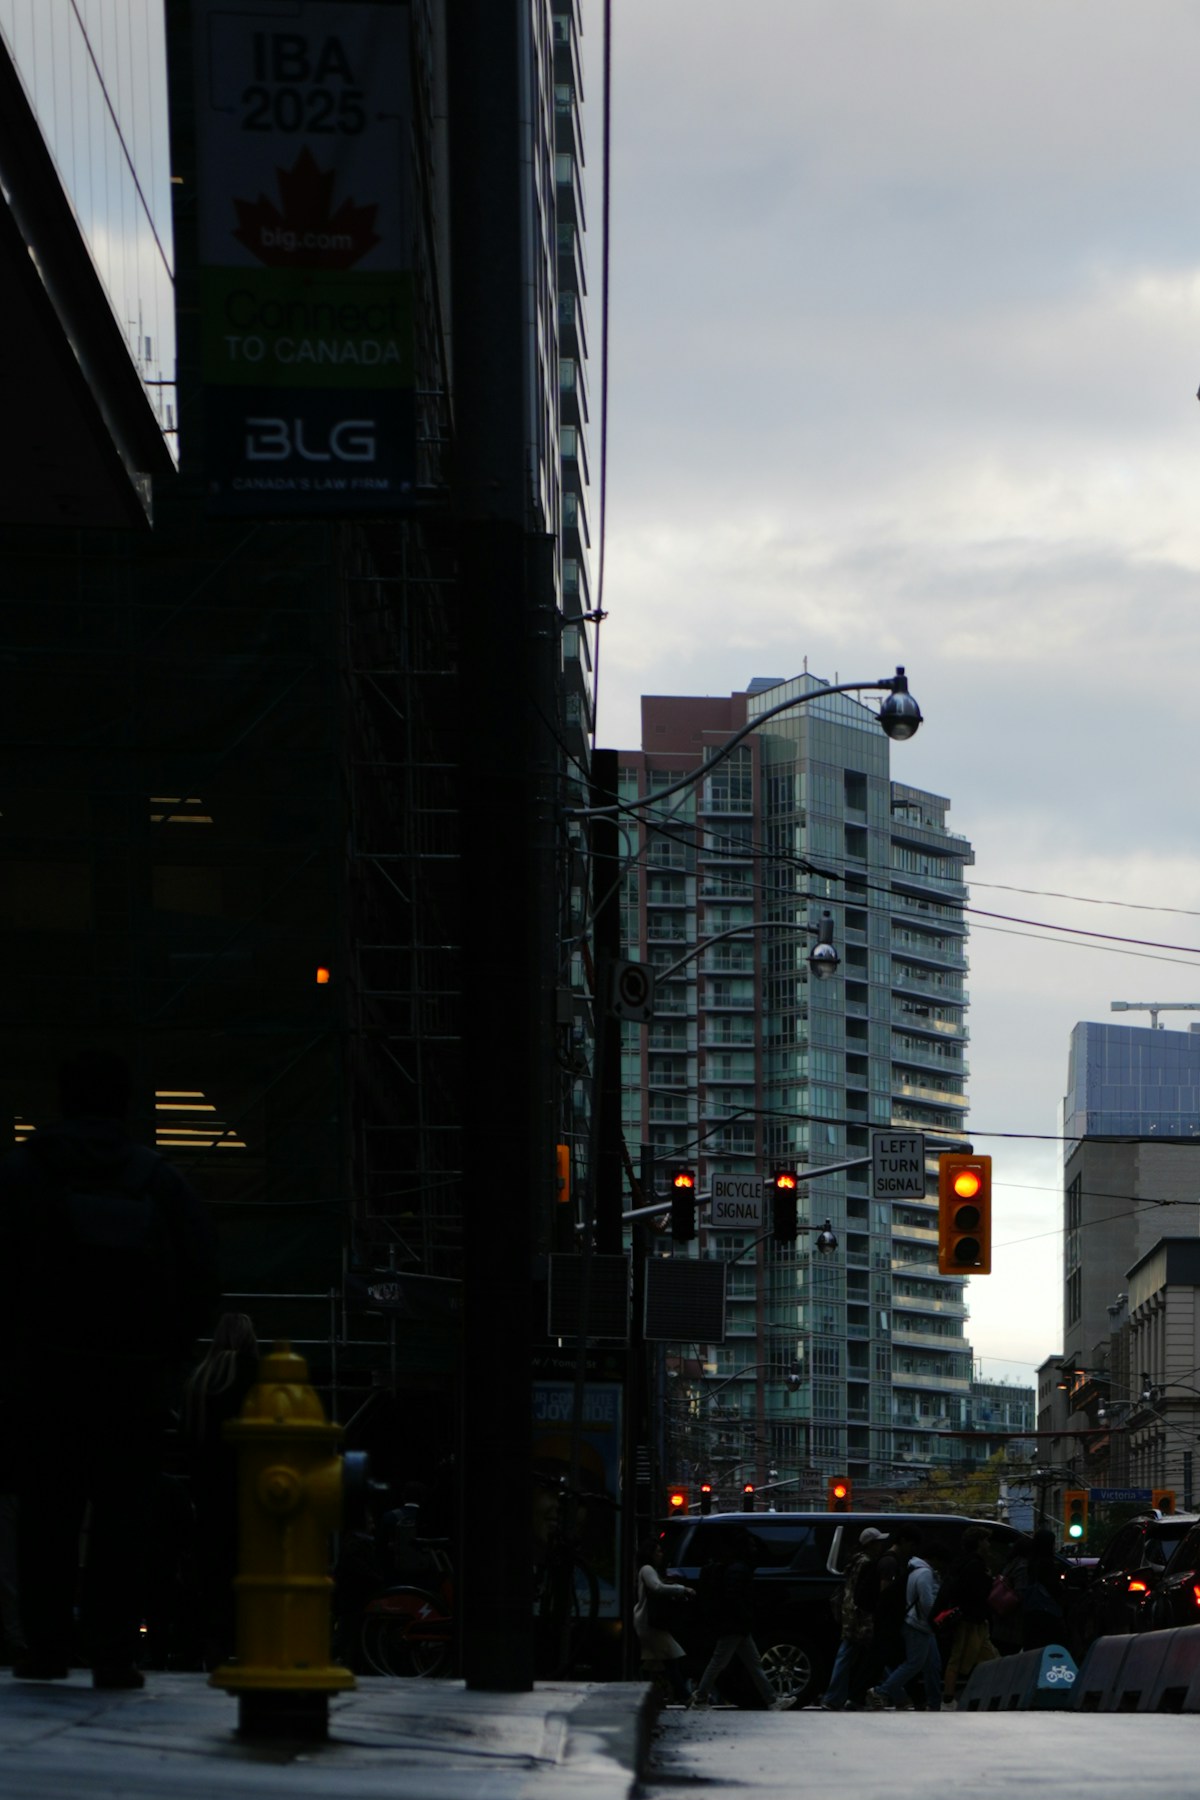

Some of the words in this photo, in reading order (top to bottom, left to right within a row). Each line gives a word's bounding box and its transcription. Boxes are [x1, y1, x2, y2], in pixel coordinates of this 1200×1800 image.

[254, 32, 354, 84] IBA
[242, 86, 366, 135] 2025
[259, 226, 353, 252] blg.com
[225, 289, 401, 333] Connect
[224, 335, 266, 363] TO
[274, 337, 401, 366] CANADA
[244, 416, 377, 463] BLG
[231, 478, 310, 491] CANADA'S
[313, 478, 347, 490] LAW
[351, 477, 389, 490] FIRM
[881, 1140, 916, 1153] LEFT
[880, 1159, 919, 1172] TURN
[716, 1181, 761, 1198] BICYCLE
[877, 1178, 922, 1191] SIGNAL
[717, 1202, 759, 1219] SIGNAL
[552, 1359, 578, 1369] Yong
[550, 1391, 613, 1405] COUTE
[1100, 1490, 1137, 1500] Victoria
